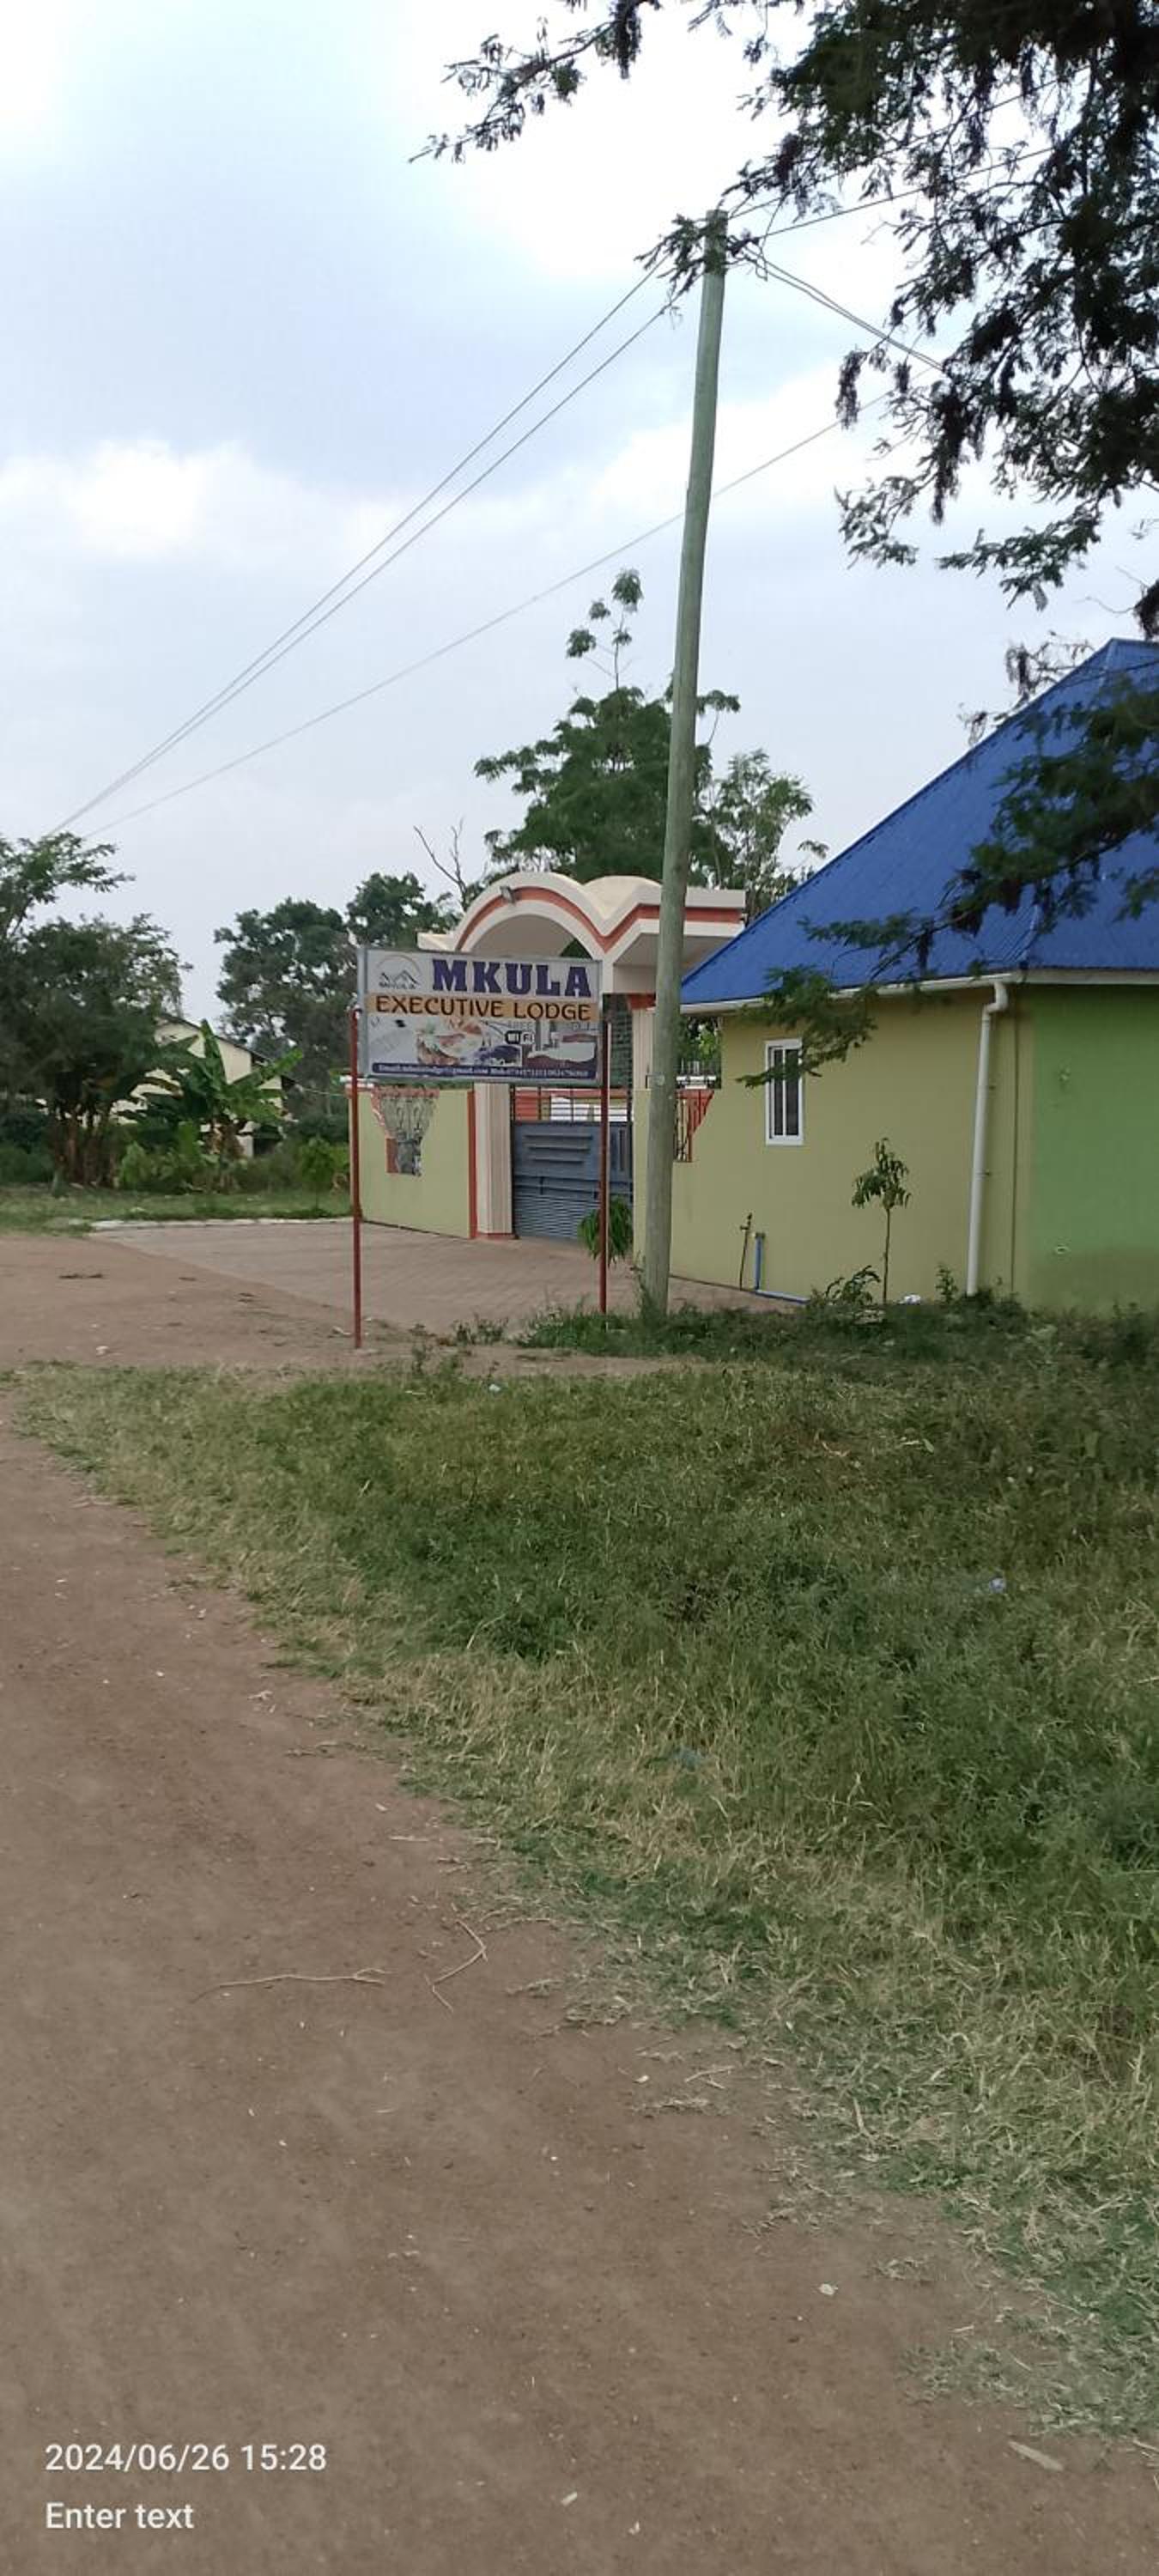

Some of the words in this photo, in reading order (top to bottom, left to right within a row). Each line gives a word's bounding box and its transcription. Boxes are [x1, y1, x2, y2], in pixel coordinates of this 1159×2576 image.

[432, 959, 592, 998] MKULA
[376, 995, 504, 1018] EXECUTIVE
[514, 1002, 592, 1021] LODGE
